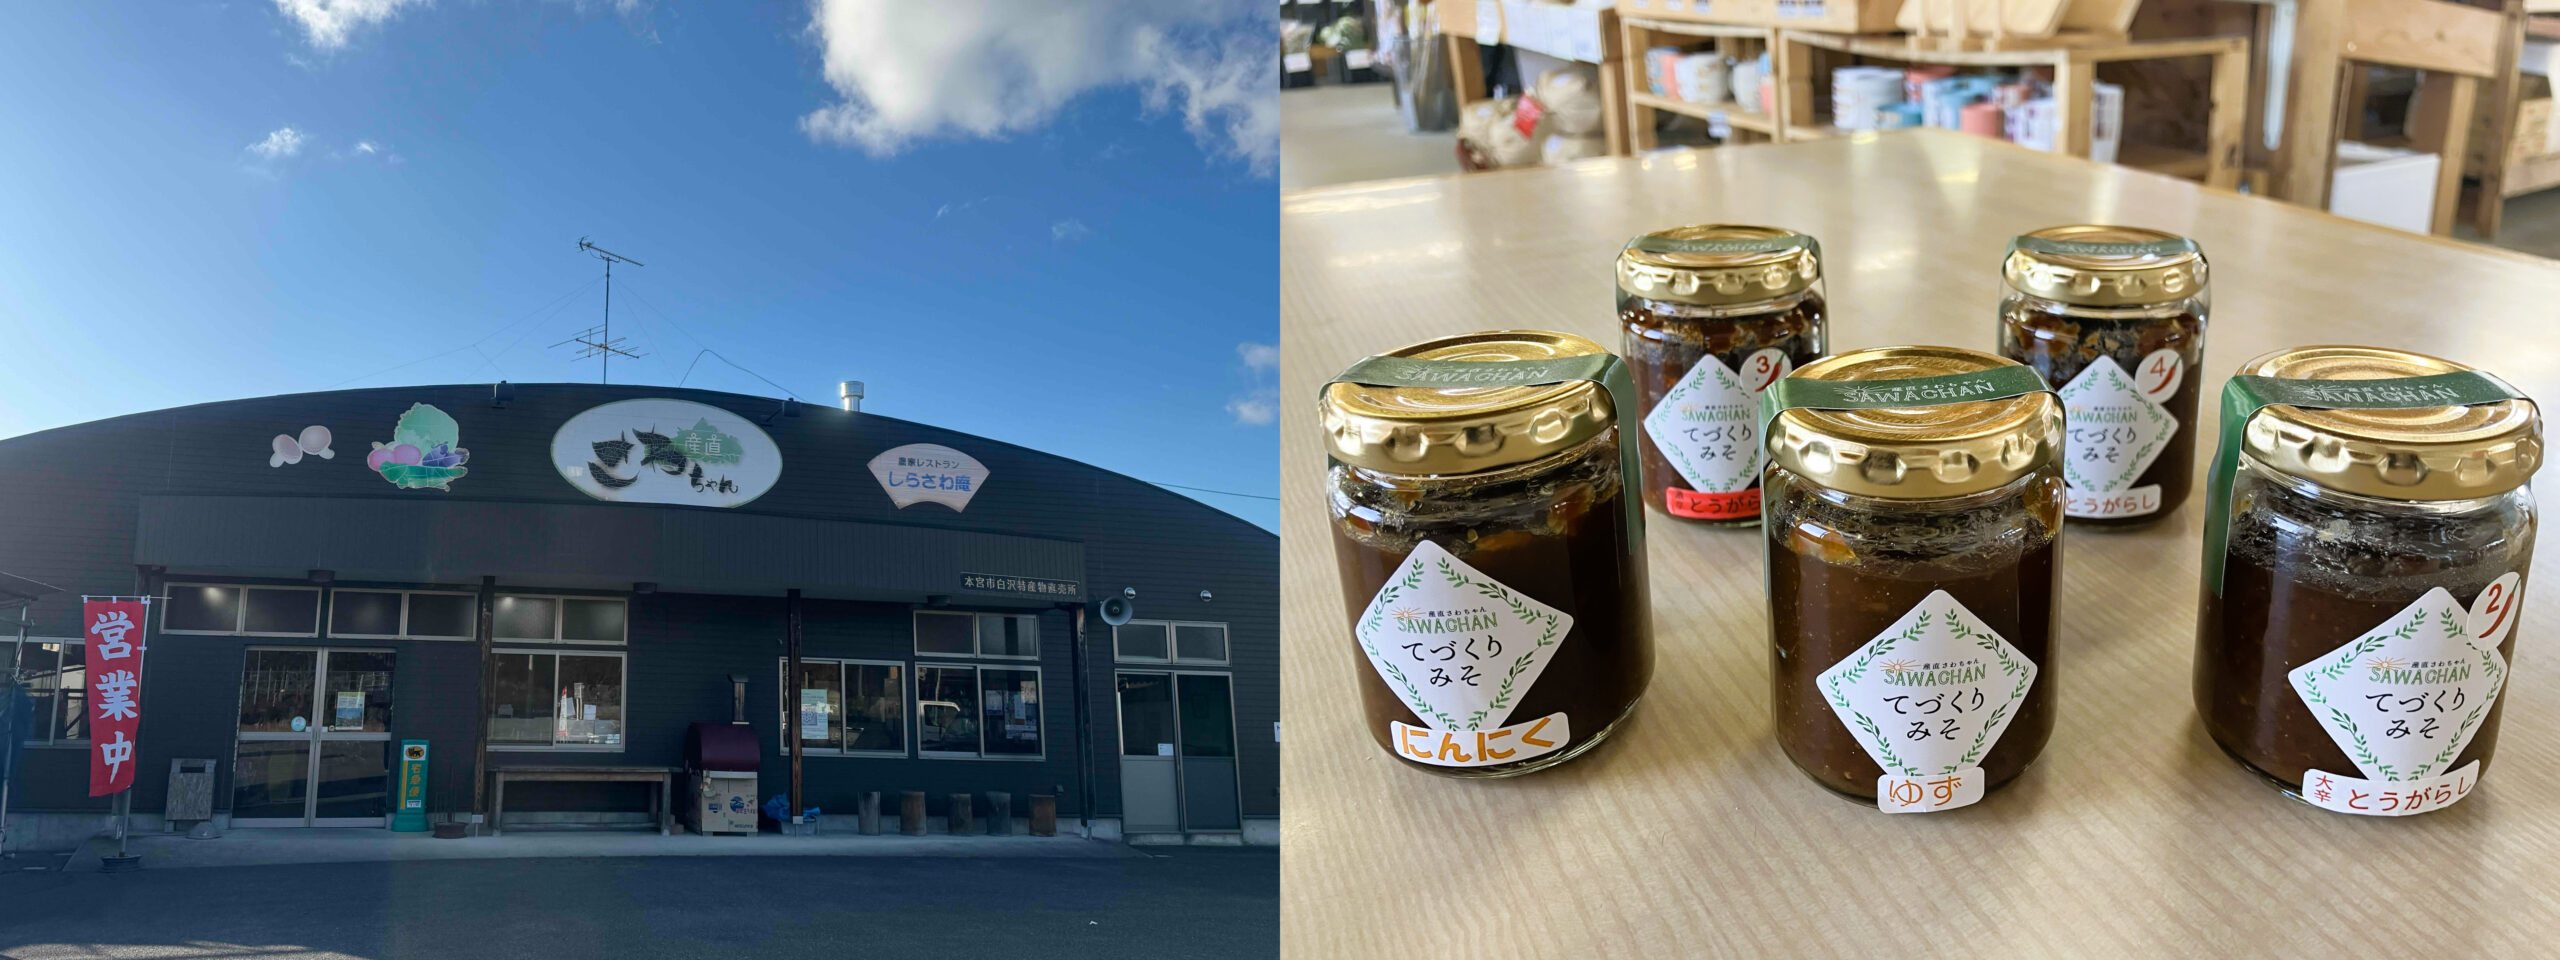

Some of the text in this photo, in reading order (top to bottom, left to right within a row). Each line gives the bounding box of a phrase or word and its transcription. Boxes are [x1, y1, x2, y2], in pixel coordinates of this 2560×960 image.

[1395, 367, 1549, 382] SAWACHAN
[1756, 355, 1770, 374] 3
[2149, 357, 2166, 377] 4
[1843, 381, 1995, 403] SAWACHAN
[2304, 387, 2460, 402] SAWACHAN
[1681, 408, 1750, 422] SAWACHAN
[2068, 409, 2137, 423] SAWACHAN
[1683, 424, 1752, 442] てづくり
[2067, 426, 2136, 444] てづくり
[685, 433, 722, 456] 産直
[1700, 444, 1737, 461] みそ
[2082, 447, 2120, 463] みそ
[898, 456, 960, 469] 農家レストラン
[888, 471, 972, 492] しらさわ庵
[2065, 495, 2155, 514] とうがらし
[965, 576, 1077, 596] 本宮市白沢特産物直売所
[2485, 583, 2502, 615] 2
[1397, 612, 1498, 634] SAWACHAN
[1401, 634, 1503, 662] てづくり
[1429, 665, 1482, 688] みそ
[1883, 663, 1987, 687] SAWACHAN
[2368, 663, 2472, 685] SAWACHAN
[90, 610, 138, 784] 営業中
[1883, 687, 1984, 715] てづくり
[2365, 687, 2465, 713] てづくり
[1906, 718, 1961, 742] みそ
[2385, 717, 2440, 740] みそ
[1401, 717, 1556, 763] にんにく
[1889, 775, 1963, 807] ゆず
[2314, 775, 2333, 802] 大辛
[2348, 776, 2472, 812] とうがらし
